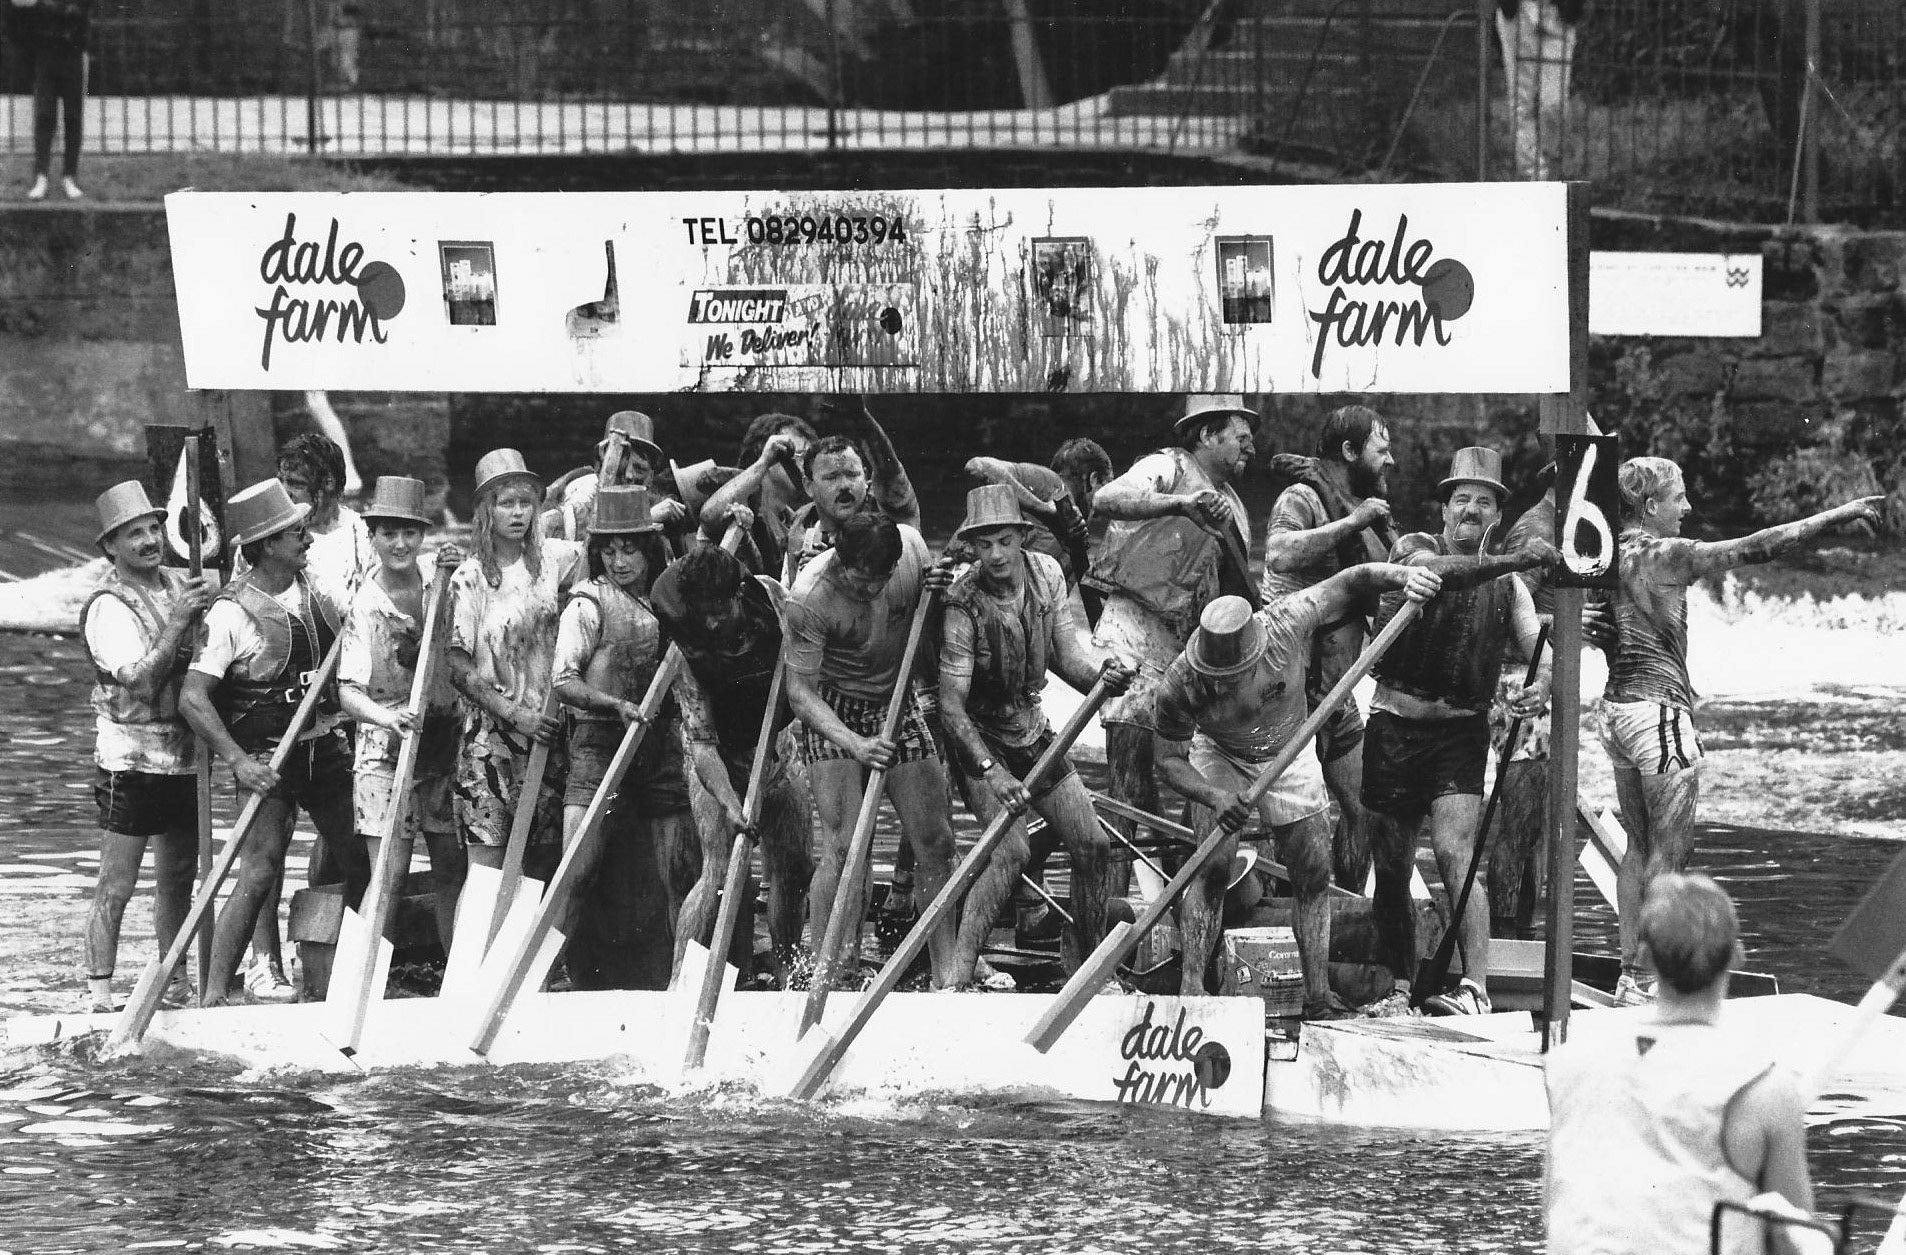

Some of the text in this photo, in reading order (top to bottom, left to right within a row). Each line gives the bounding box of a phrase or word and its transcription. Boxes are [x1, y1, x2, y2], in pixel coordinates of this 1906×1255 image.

[260, 211, 382, 286] dale
[682, 216, 906, 245] TEL 082940394
[1318, 207, 1452, 287] dale
[254, 285, 388, 372] farm
[705, 333, 733, 361] We
[740, 322, 821, 356] Deliver!
[1308, 287, 1452, 379] farm
[1562, 442, 1614, 577] 6
[1121, 1001, 1213, 1061] dale
